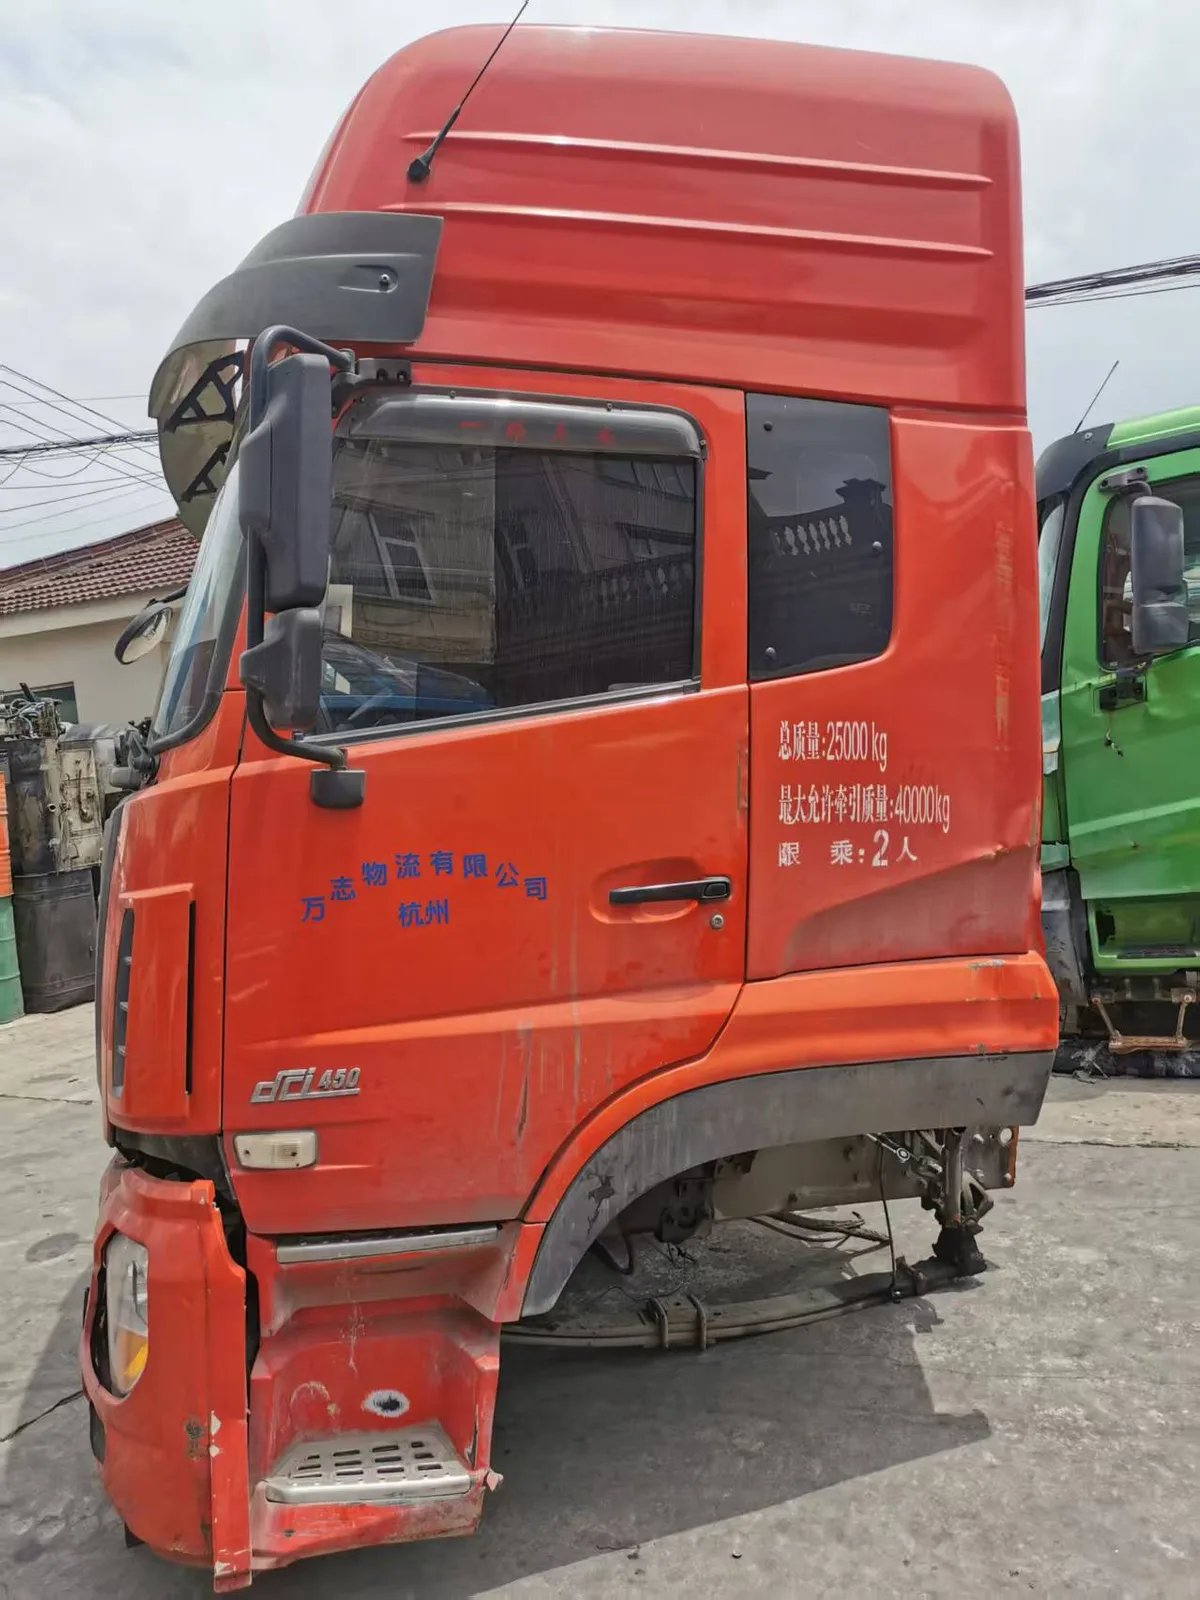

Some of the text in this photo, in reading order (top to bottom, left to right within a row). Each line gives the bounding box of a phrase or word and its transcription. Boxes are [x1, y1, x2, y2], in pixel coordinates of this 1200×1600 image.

[300, 850, 548, 922] 万志物流有限公司
[398, 899, 449, 928] 杭州
[317, 1067, 361, 1089] 450
